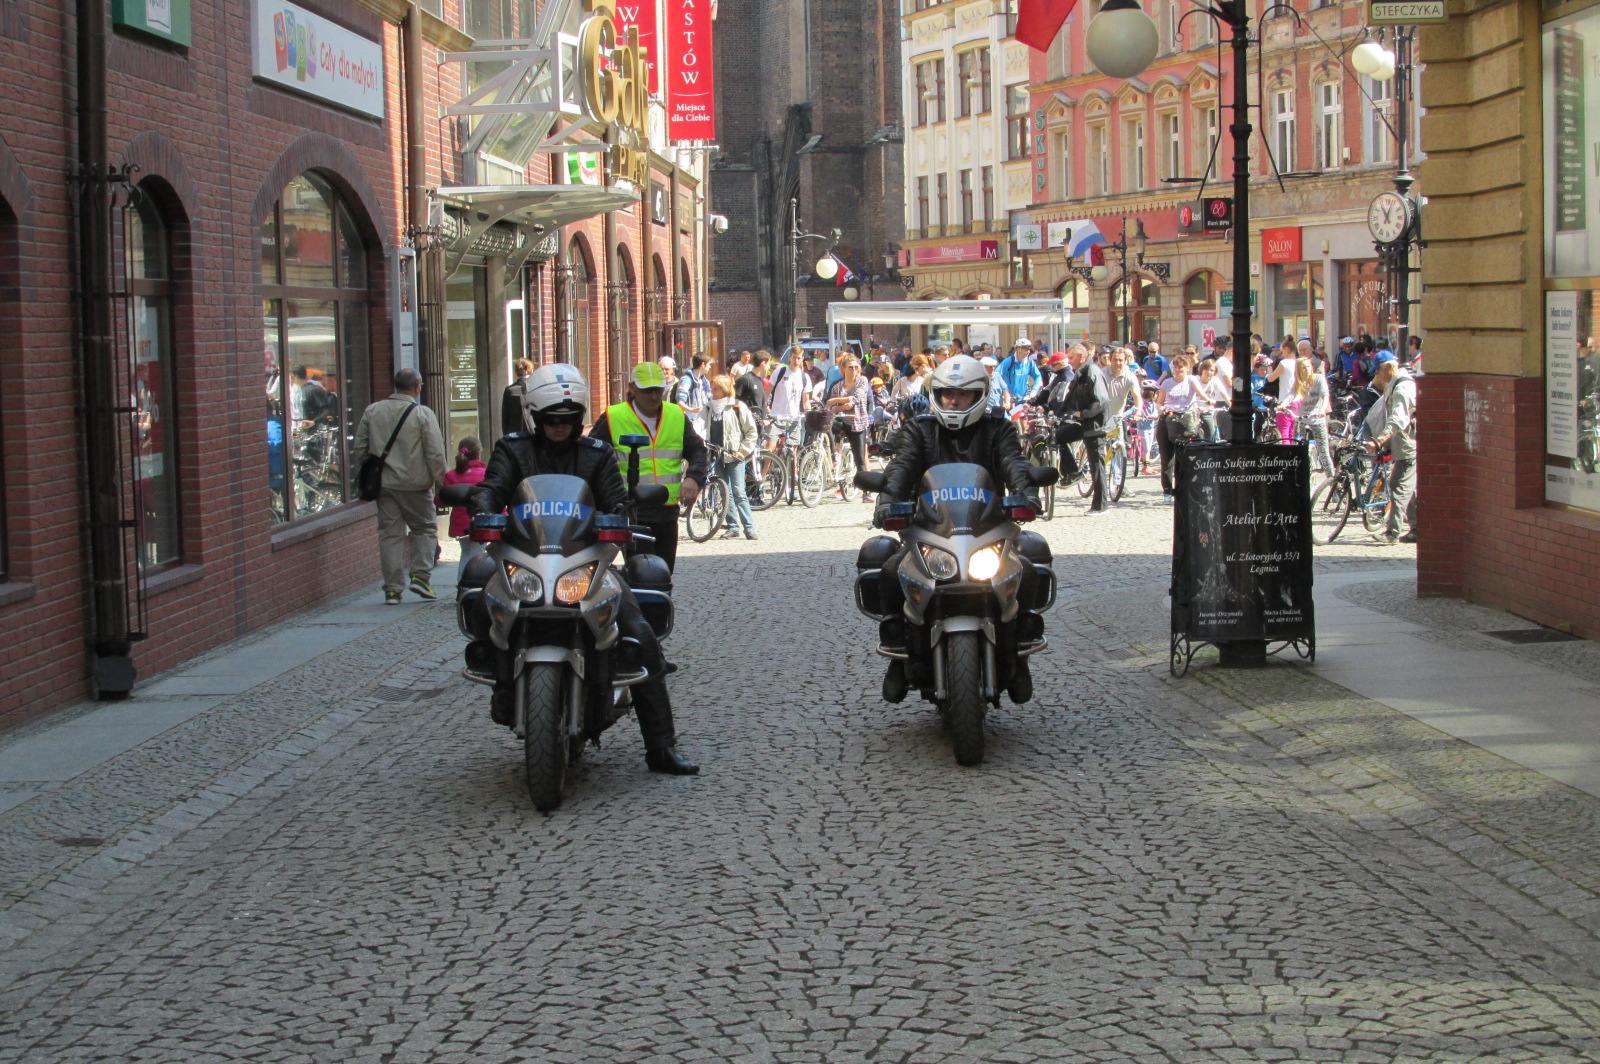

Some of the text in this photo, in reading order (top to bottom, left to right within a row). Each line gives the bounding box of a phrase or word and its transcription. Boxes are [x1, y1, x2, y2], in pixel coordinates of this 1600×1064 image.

[1375, 5, 1440, 17] STEFCZYKA
[676, 103, 706, 113] Miejsce
[671, 113, 711, 122] dla Ciebie
[1035, 110, 1045, 192] SKUP
[1268, 239, 1293, 254] SALON
[1193, 454, 1299, 470] Salon Sukien Ślubnych
[1212, 470, 1284, 485] i wieczorowych
[931, 487, 986, 504] POLICJA
[523, 501, 582, 519] POLICJA
[1222, 511, 1298, 527] Atelier L'Arte
[1226, 552, 1236, 561] ul.
[1249, 564, 1279, 575] Legnica
